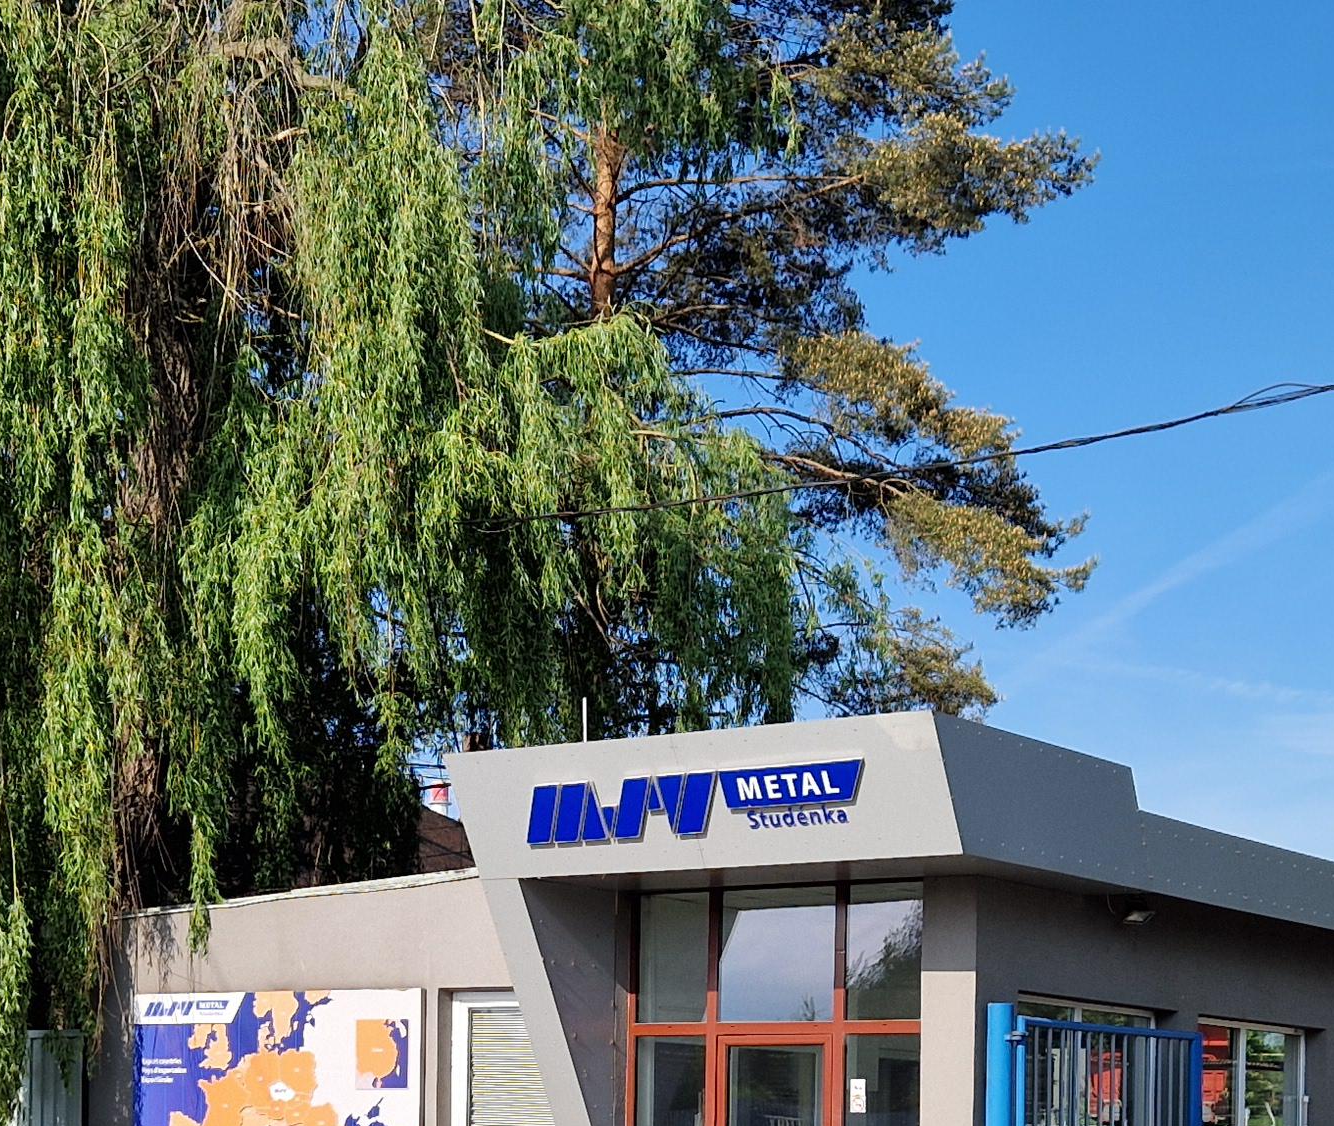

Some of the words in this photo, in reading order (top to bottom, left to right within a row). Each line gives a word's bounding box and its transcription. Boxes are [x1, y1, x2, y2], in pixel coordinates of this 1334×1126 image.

[736, 770, 840, 801] METAL
[747, 804, 849, 830] Studénka
[199, 1001, 225, 1009] METAL
